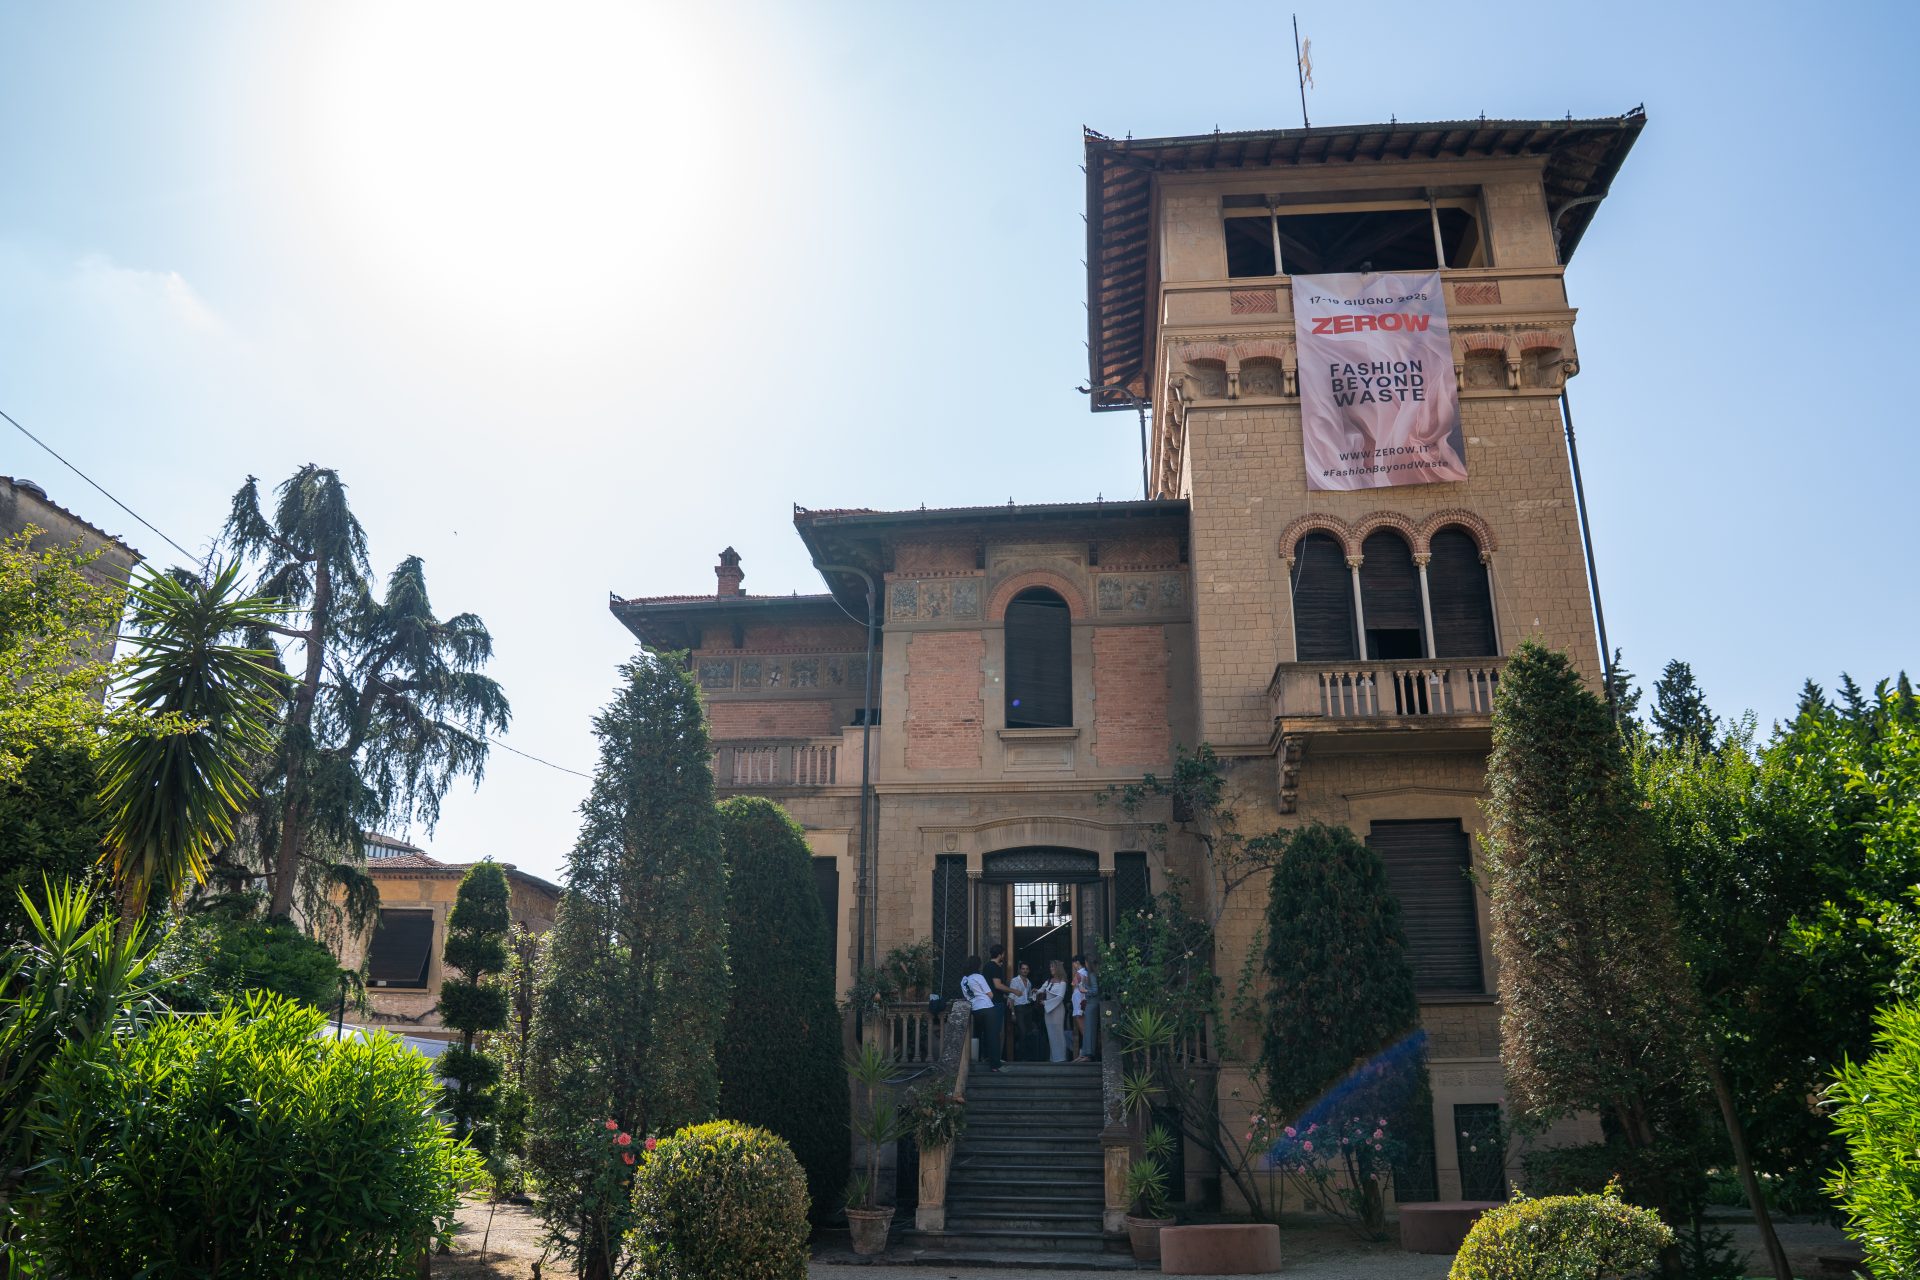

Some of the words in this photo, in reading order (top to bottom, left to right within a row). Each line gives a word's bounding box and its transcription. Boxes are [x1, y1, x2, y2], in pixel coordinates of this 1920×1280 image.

[1344, 297, 1394, 306] GIUGNO
[1311, 313, 1430, 335] ZEROW
[1330, 360, 1423, 377] FASHION
[1332, 374, 1424, 393] BEYOND
[1334, 388, 1426, 407] WASTE
[1323, 459, 1449, 477] #FashionBeyondWaste
